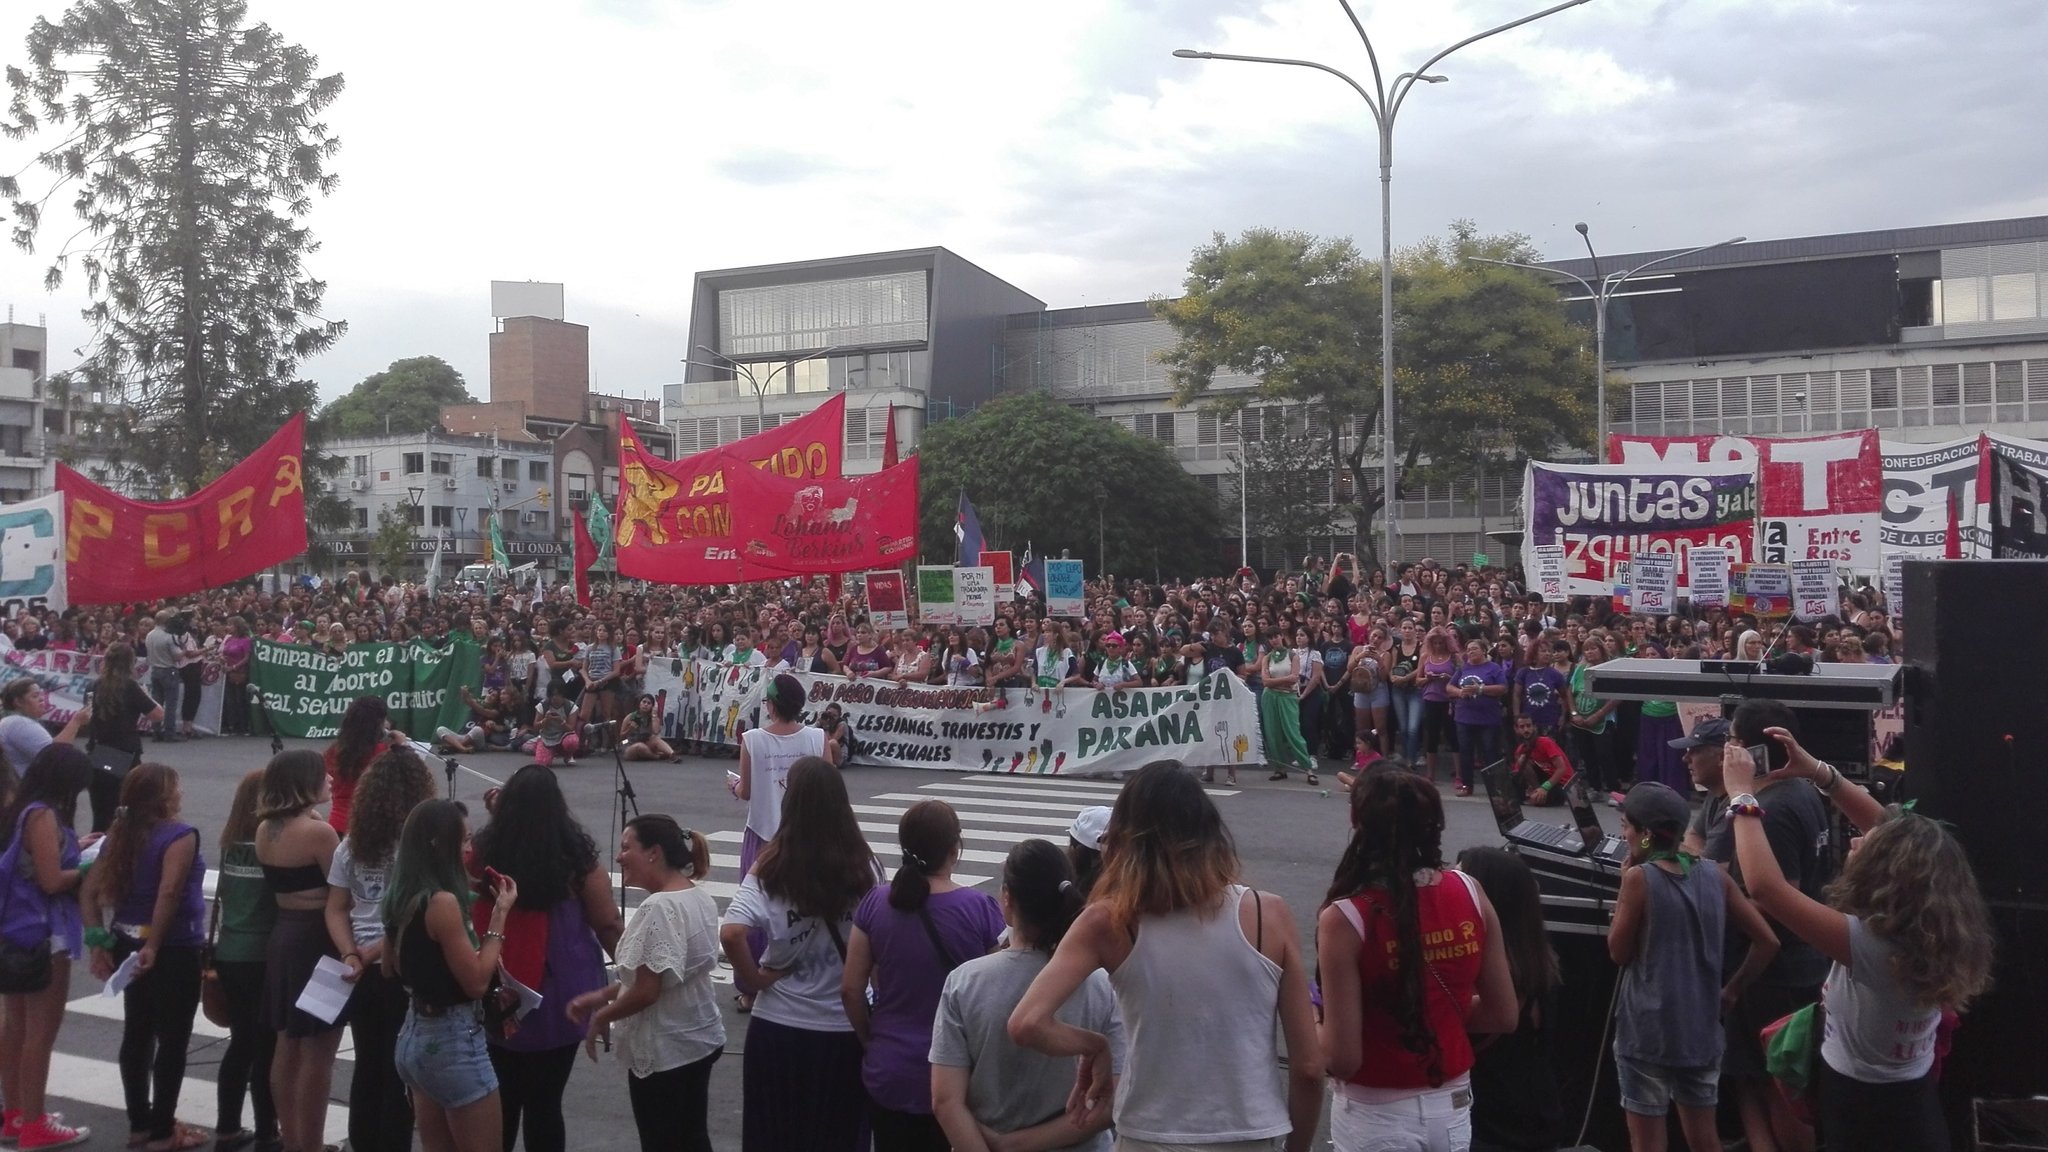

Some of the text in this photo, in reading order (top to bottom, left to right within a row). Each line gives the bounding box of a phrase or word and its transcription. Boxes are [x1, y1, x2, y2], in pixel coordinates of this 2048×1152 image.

[508, 542, 563, 554] TU ONDA
[4, 649, 103, 675] MARZ
[254, 641, 338, 672] ampaña
[294, 674, 317, 692] al
[856, 715, 938, 740] LESBIANAS,
[941, 721, 1023, 741] TRAVESTIS
[1029, 722, 1041, 741] Y
[1077, 702, 1204, 759] PARANÁ
[1388, 941, 1479, 970] CUNISTA
